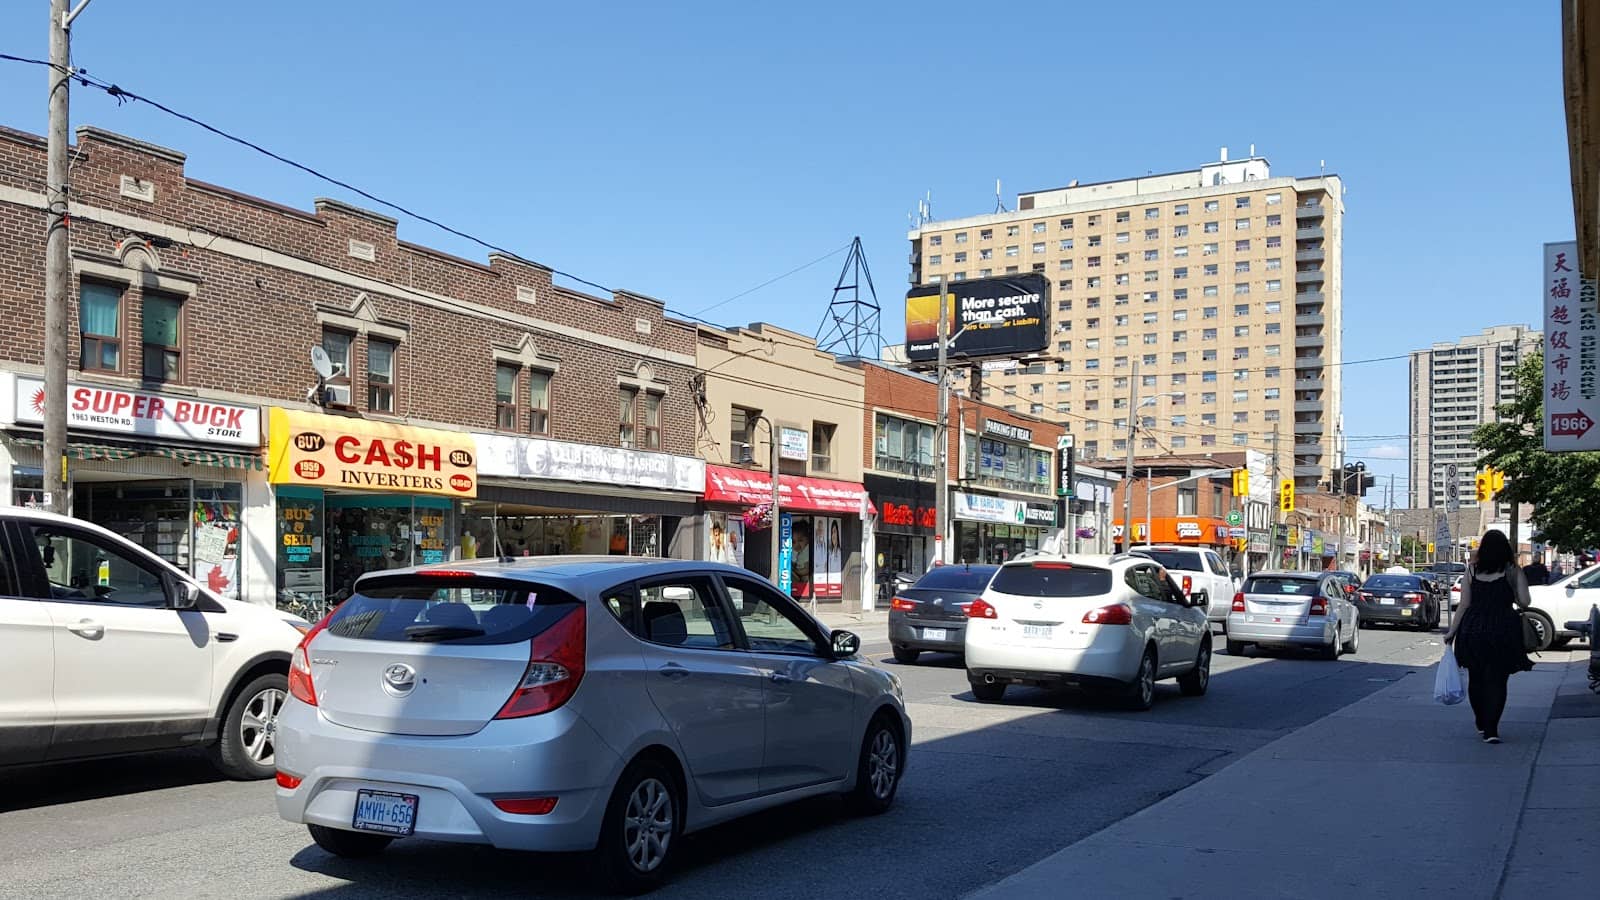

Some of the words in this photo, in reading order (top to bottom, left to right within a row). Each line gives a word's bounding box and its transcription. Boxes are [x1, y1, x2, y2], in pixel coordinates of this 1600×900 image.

[962, 297, 995, 311] More
[998, 293, 1040, 306] secure
[962, 310, 992, 322] than
[995, 305, 1026, 318] cash.
[72, 388, 165, 420] SUPER
[174, 401, 245, 430] BUCK
[72, 413, 89, 422] 1963
[90, 415, 120, 425] WESTON
[121, 418, 133, 426] RD.
[1552, 417, 1589, 431] 1966
[208, 428, 242, 438] STORE
[298, 435, 320, 449] BUY
[335, 435, 440, 471] CA$H
[452, 452, 470, 465] SELL
[300, 462, 320, 472] 1959
[341, 470, 443, 489] INVERTERS
[285, 508, 314, 520] BUY
[284, 535, 313, 546] SELL
[781, 517, 793, 591] DENTIST
